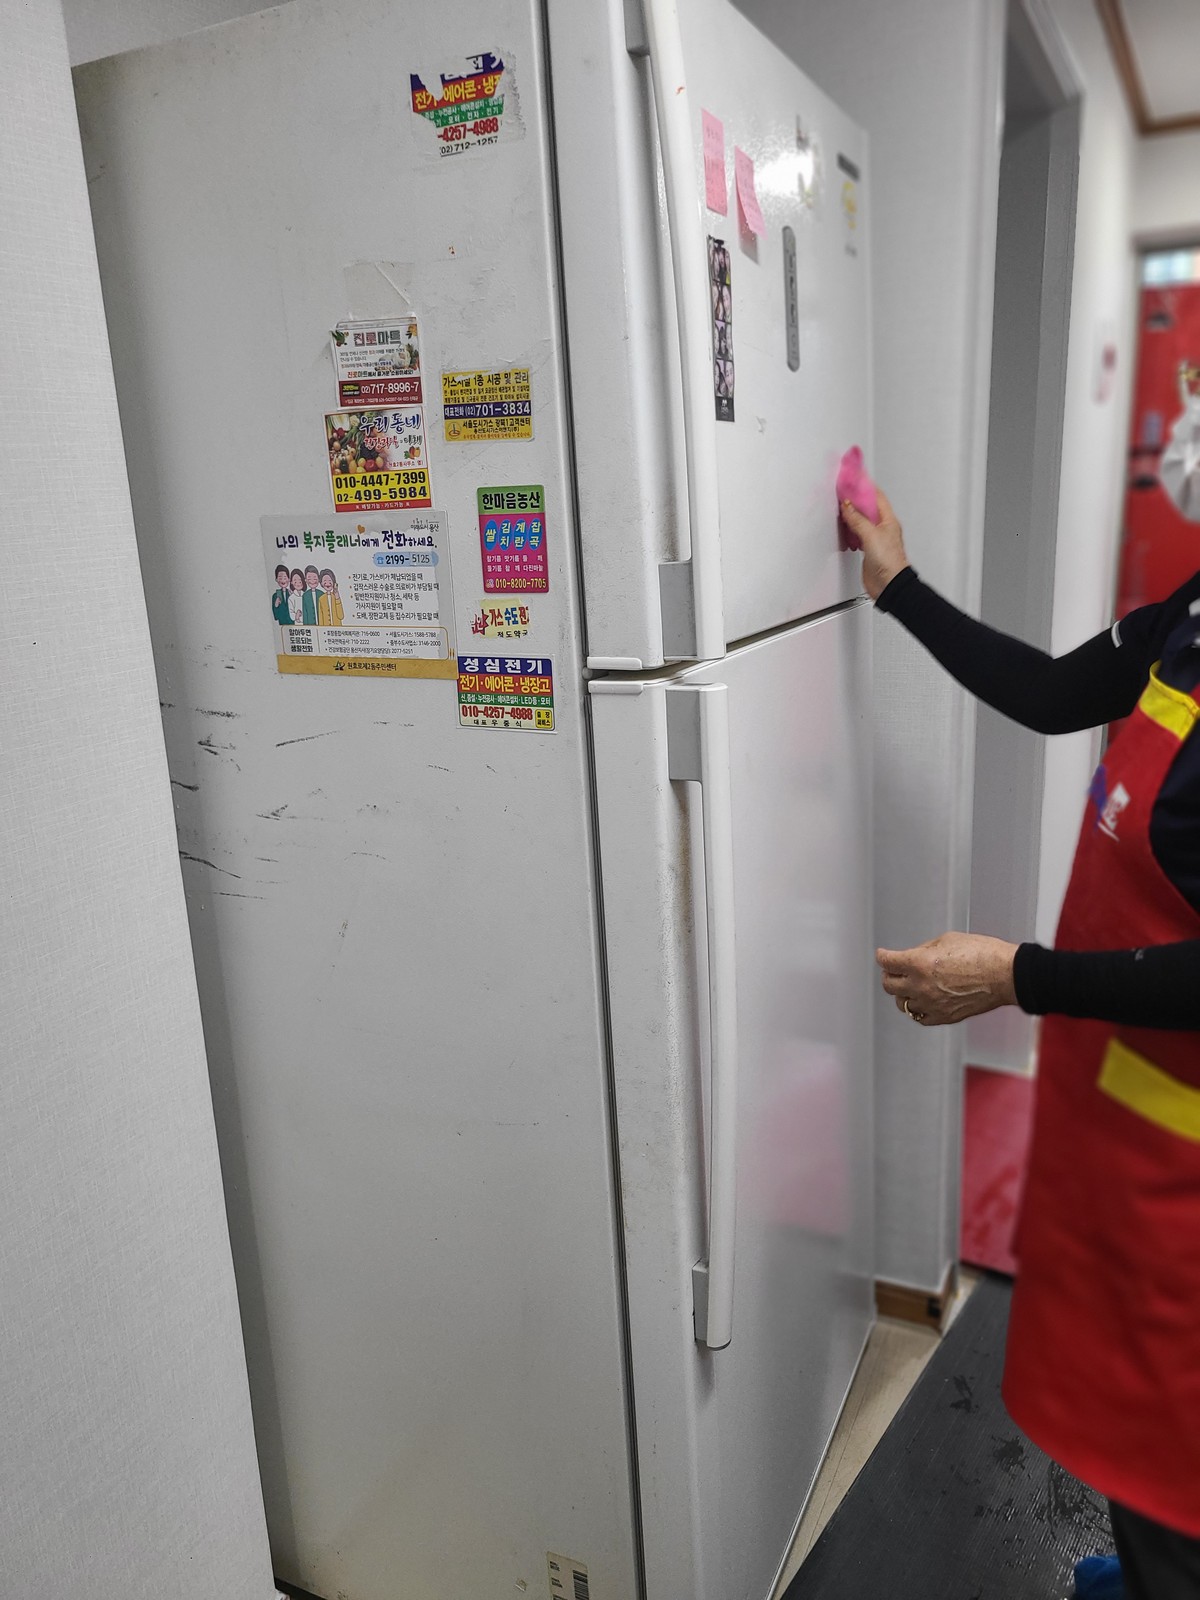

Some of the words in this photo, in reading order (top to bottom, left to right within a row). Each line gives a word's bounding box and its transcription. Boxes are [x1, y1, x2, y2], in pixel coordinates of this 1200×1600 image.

[487, 373, 501, 386] 시공
[504, 372, 511, 385] 및
[514, 371, 529, 384] 관리
[335, 471, 426, 489] 010-4447-7399
[337, 486, 427, 503] 02-499-5984
[482, 491, 541, 510] 한마음농산
[276, 534, 299, 548] 나의
[303, 530, 380, 553] 복지플래너에게
[381, 530, 437, 550] 전화하세요.
[485, 528, 496, 543] 쌀
[500, 522, 511, 547] 김치
[514, 522, 526, 548] 계란
[529, 521, 542, 547] 잡곡
[495, 578, 547, 589] 010-8200-7705
[413, 593, 420, 601] 등
[461, 705, 533, 721] 010-4257-4988
